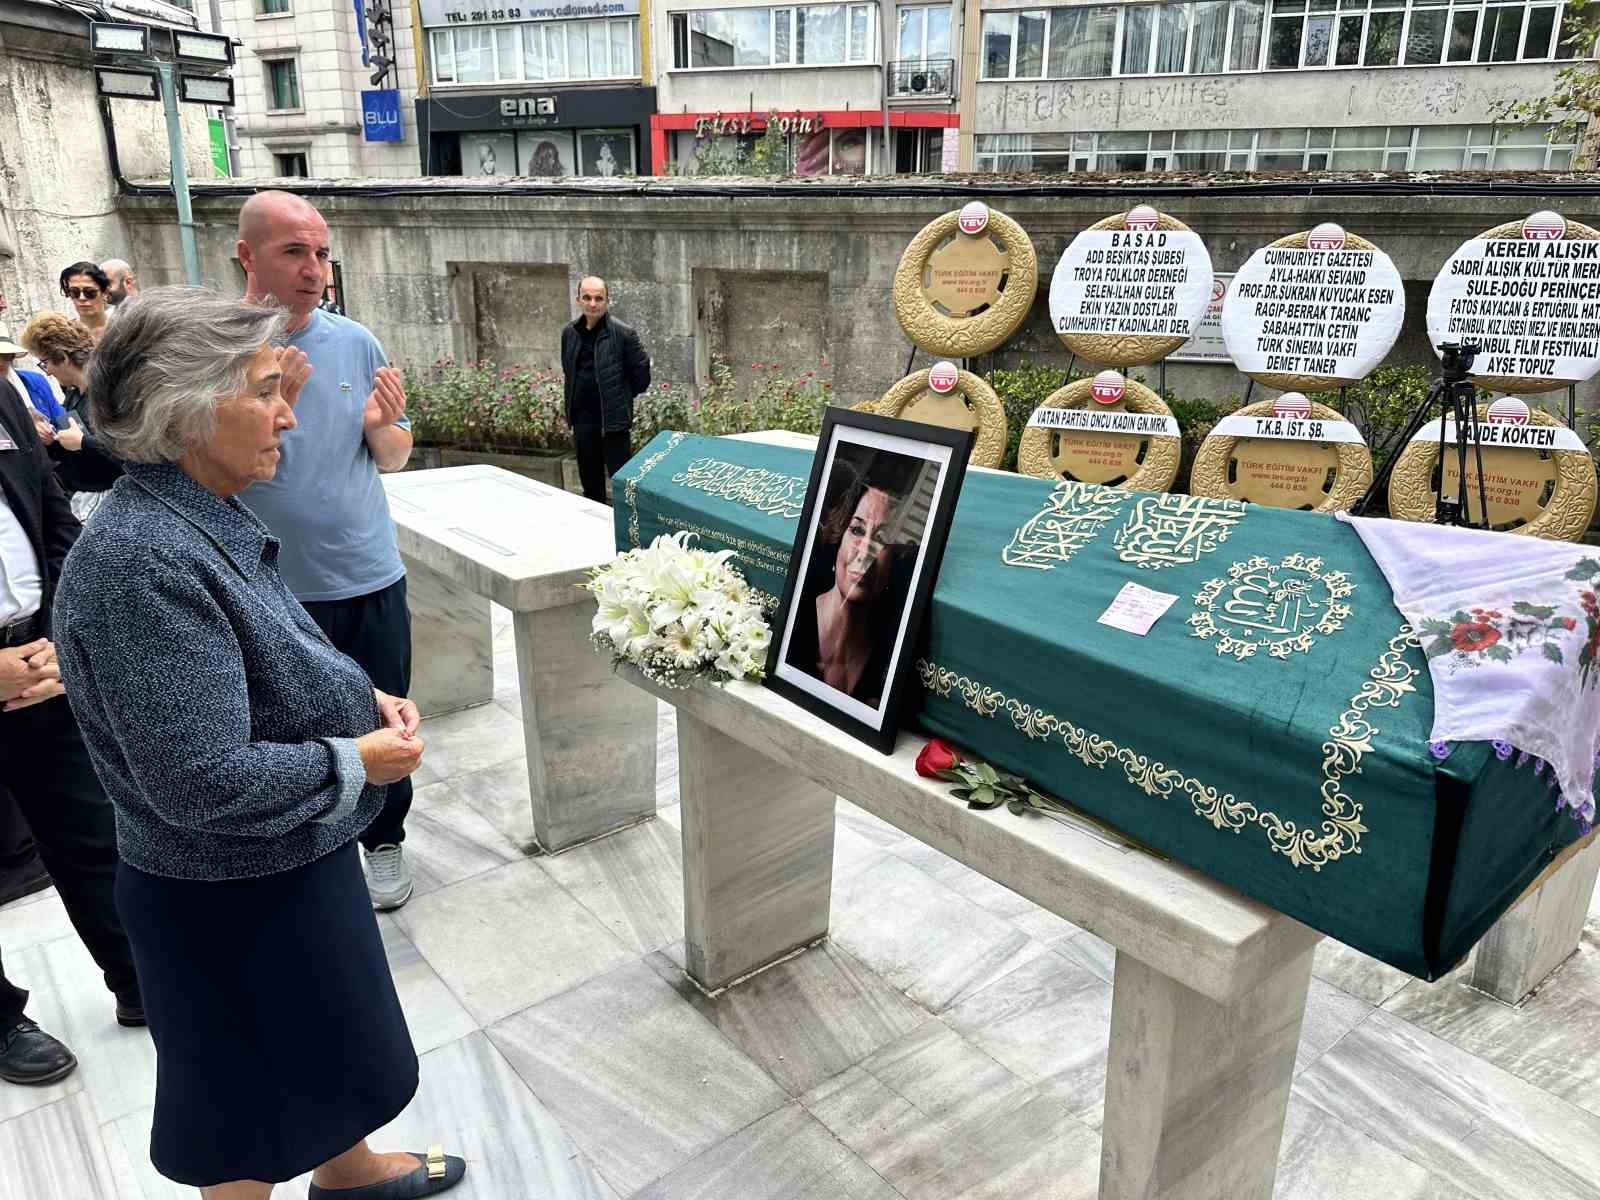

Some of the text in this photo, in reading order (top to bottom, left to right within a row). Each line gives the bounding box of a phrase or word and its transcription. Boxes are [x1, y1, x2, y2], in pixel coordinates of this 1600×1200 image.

[501, 97, 555, 116] ena
[365, 110, 397, 124] BLU
[963, 219, 984, 227] TEV
[1127, 223, 1156, 231] TEV
[1527, 230, 1560, 238] TEV
[1313, 241, 1341, 249] TEV
[1485, 242, 1600, 260] KEREM ALIŞIK
[1086, 250, 1103, 264] ADD
[1074, 268, 1102, 281] TROYA
[1105, 268, 1145, 282] FOLKLOR
[1452, 258, 1484, 275] SADRİ
[1524, 260, 1570, 278] KÜLTÜR
[1269, 269, 1365, 285] AYLA-HAKKI SEVAND
[1319, 287, 1366, 303] KUYUCAK
[1368, 290, 1393, 304] ESEN
[1104, 302, 1130, 315] YAZIN
[1133, 303, 1177, 316] DOSTLARI
[1480, 300, 1521, 316] KAYACAN
[1523, 302, 1529, 316] &
[1119, 319, 1168, 333] KADINLARI
[1170, 320, 1190, 334] DER.
[1487, 319, 1500, 334] KIZ
[1257, 336, 1283, 352] TÜRK
[1327, 342, 1357, 357] VAKFI
[1267, 356, 1336, 373] DEMET TANER
[1519, 359, 1555, 375] TOPUZ
[1094, 387, 1121, 396] TEV
[1038, 410, 1060, 424] VATAN
[1112, 415, 1137, 430] KADIN
[1257, 420, 1283, 435] T.K.B.
[1456, 425, 1498, 441] ANDE
